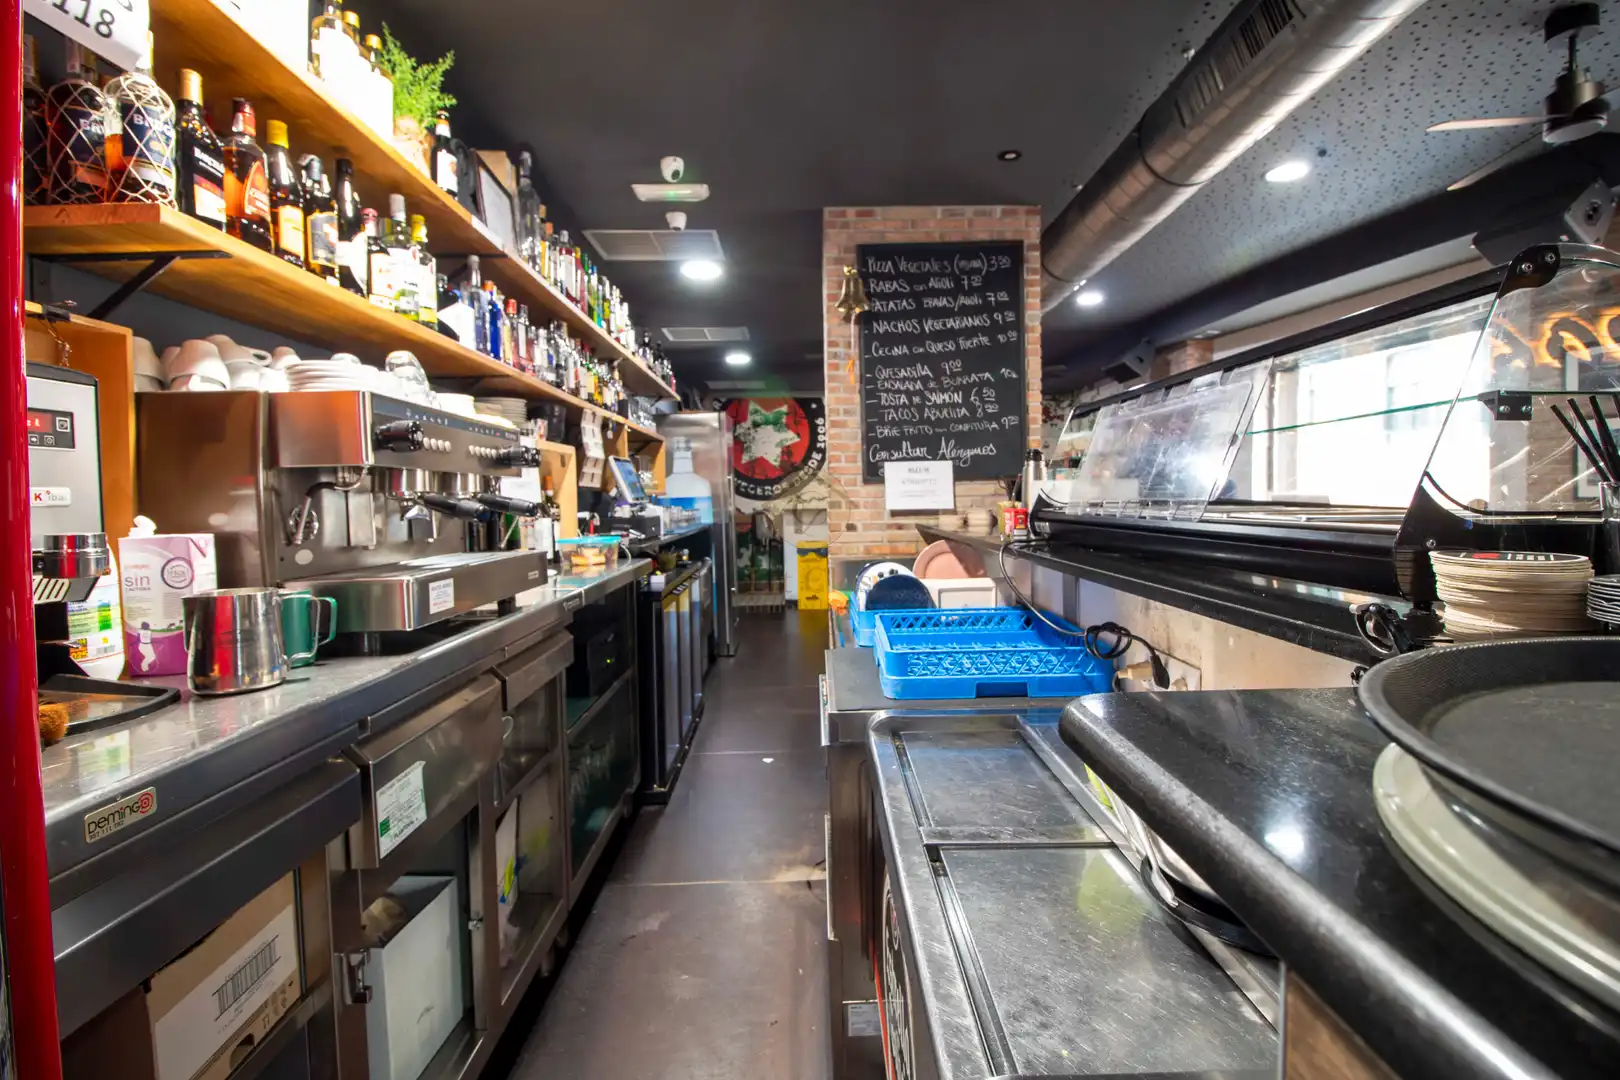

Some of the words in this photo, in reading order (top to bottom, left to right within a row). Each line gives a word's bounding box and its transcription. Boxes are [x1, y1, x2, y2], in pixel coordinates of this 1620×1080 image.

[870, 279, 910, 293] RABAS
[872, 298, 916, 312] PATATAS
[873, 319, 920, 334] NACHOS
[876, 392, 909, 405] TOSTA
[879, 407, 919, 421] TACOS
[815, 417, 825, 449] 1906
[869, 440, 932, 462] Consultar
[124, 576, 150, 587] sin
